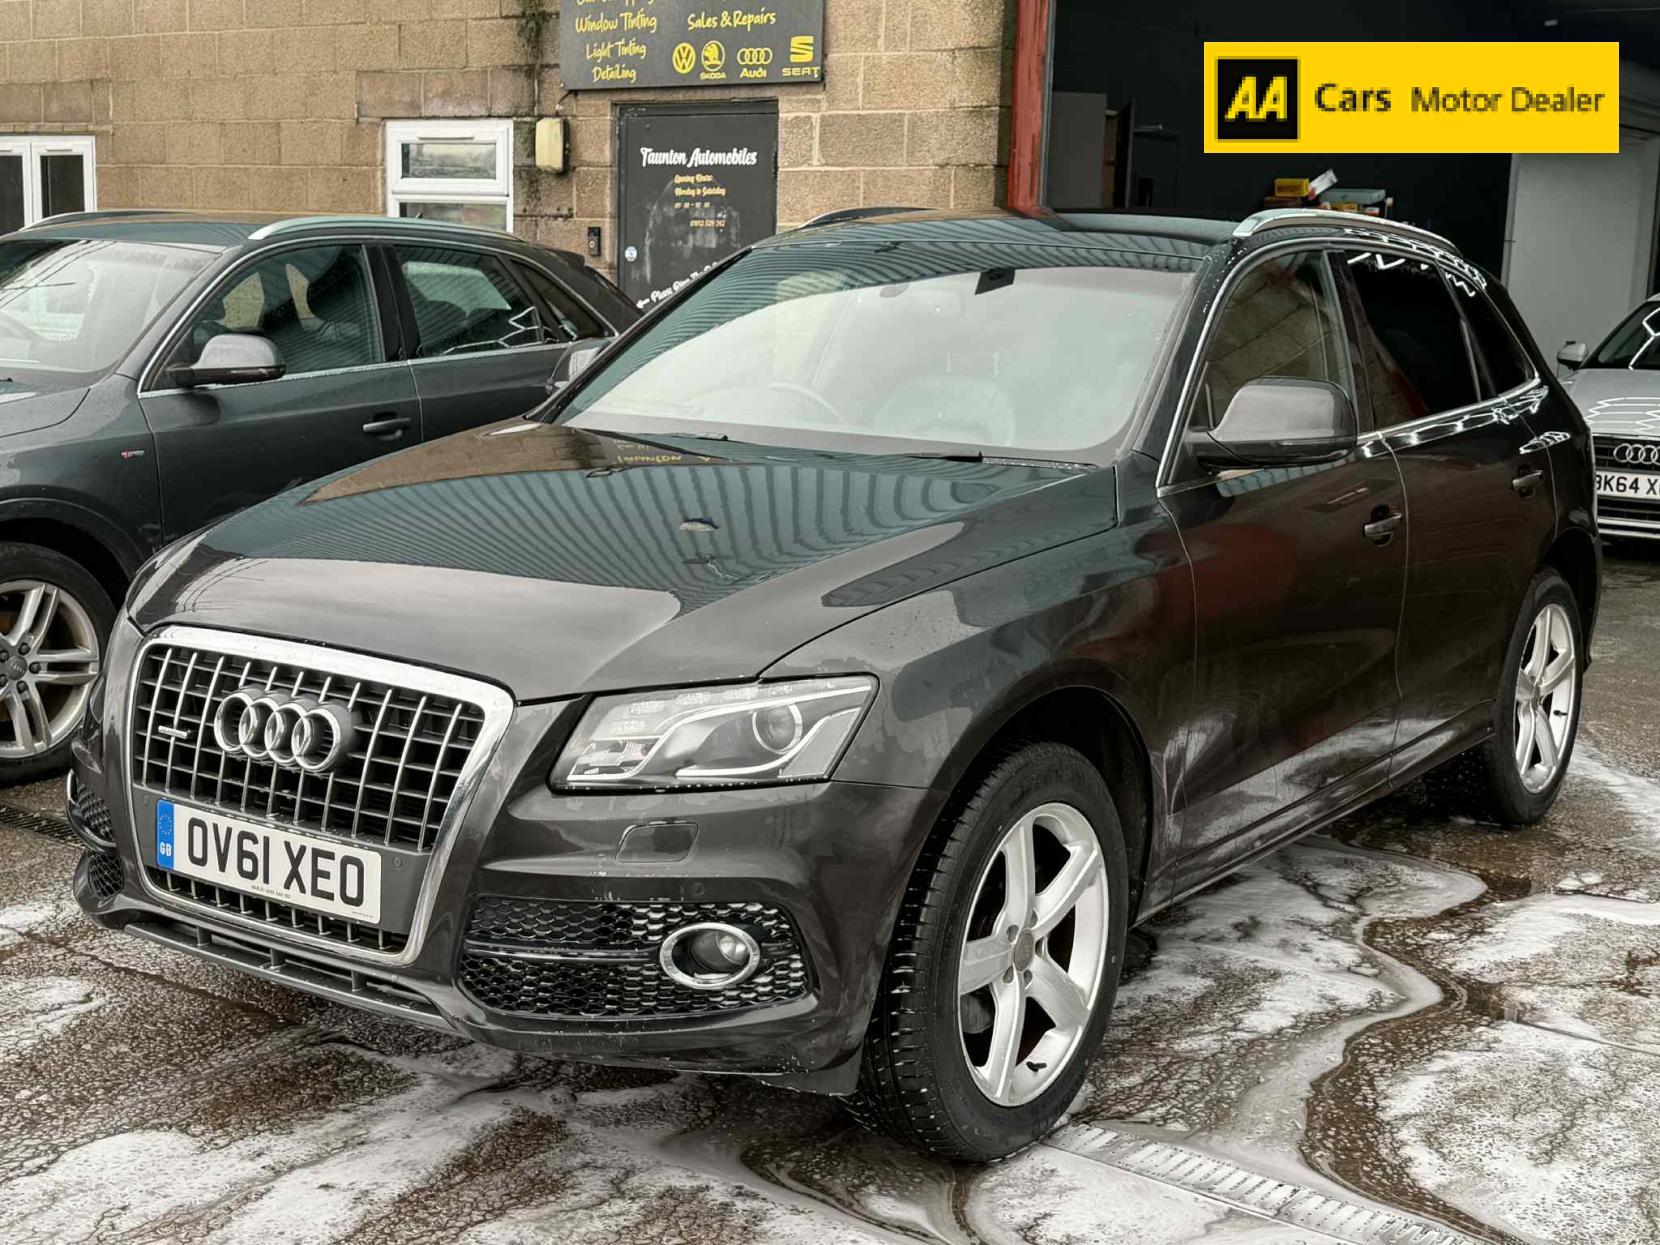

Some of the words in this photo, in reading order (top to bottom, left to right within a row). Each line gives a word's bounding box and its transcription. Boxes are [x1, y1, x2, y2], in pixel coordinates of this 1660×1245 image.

[575, 12, 618, 32] Window
[620, 8, 657, 33] Tinting
[687, 13, 718, 30] Sales
[733, 8, 776, 31] Repairs
[586, 42, 614, 63] Light
[614, 37, 647, 60] Tinting
[591, 63, 637, 83] Detailing
[740, 67, 768, 79] Audi
[782, 66, 821, 78] SEAT
[640, 147, 687, 167] Taunton
[687, 147, 758, 168] Automobiles
[159, 841, 172, 857] GB
[187, 816, 270, 885] OV61
[283, 840, 365, 907] XEO
